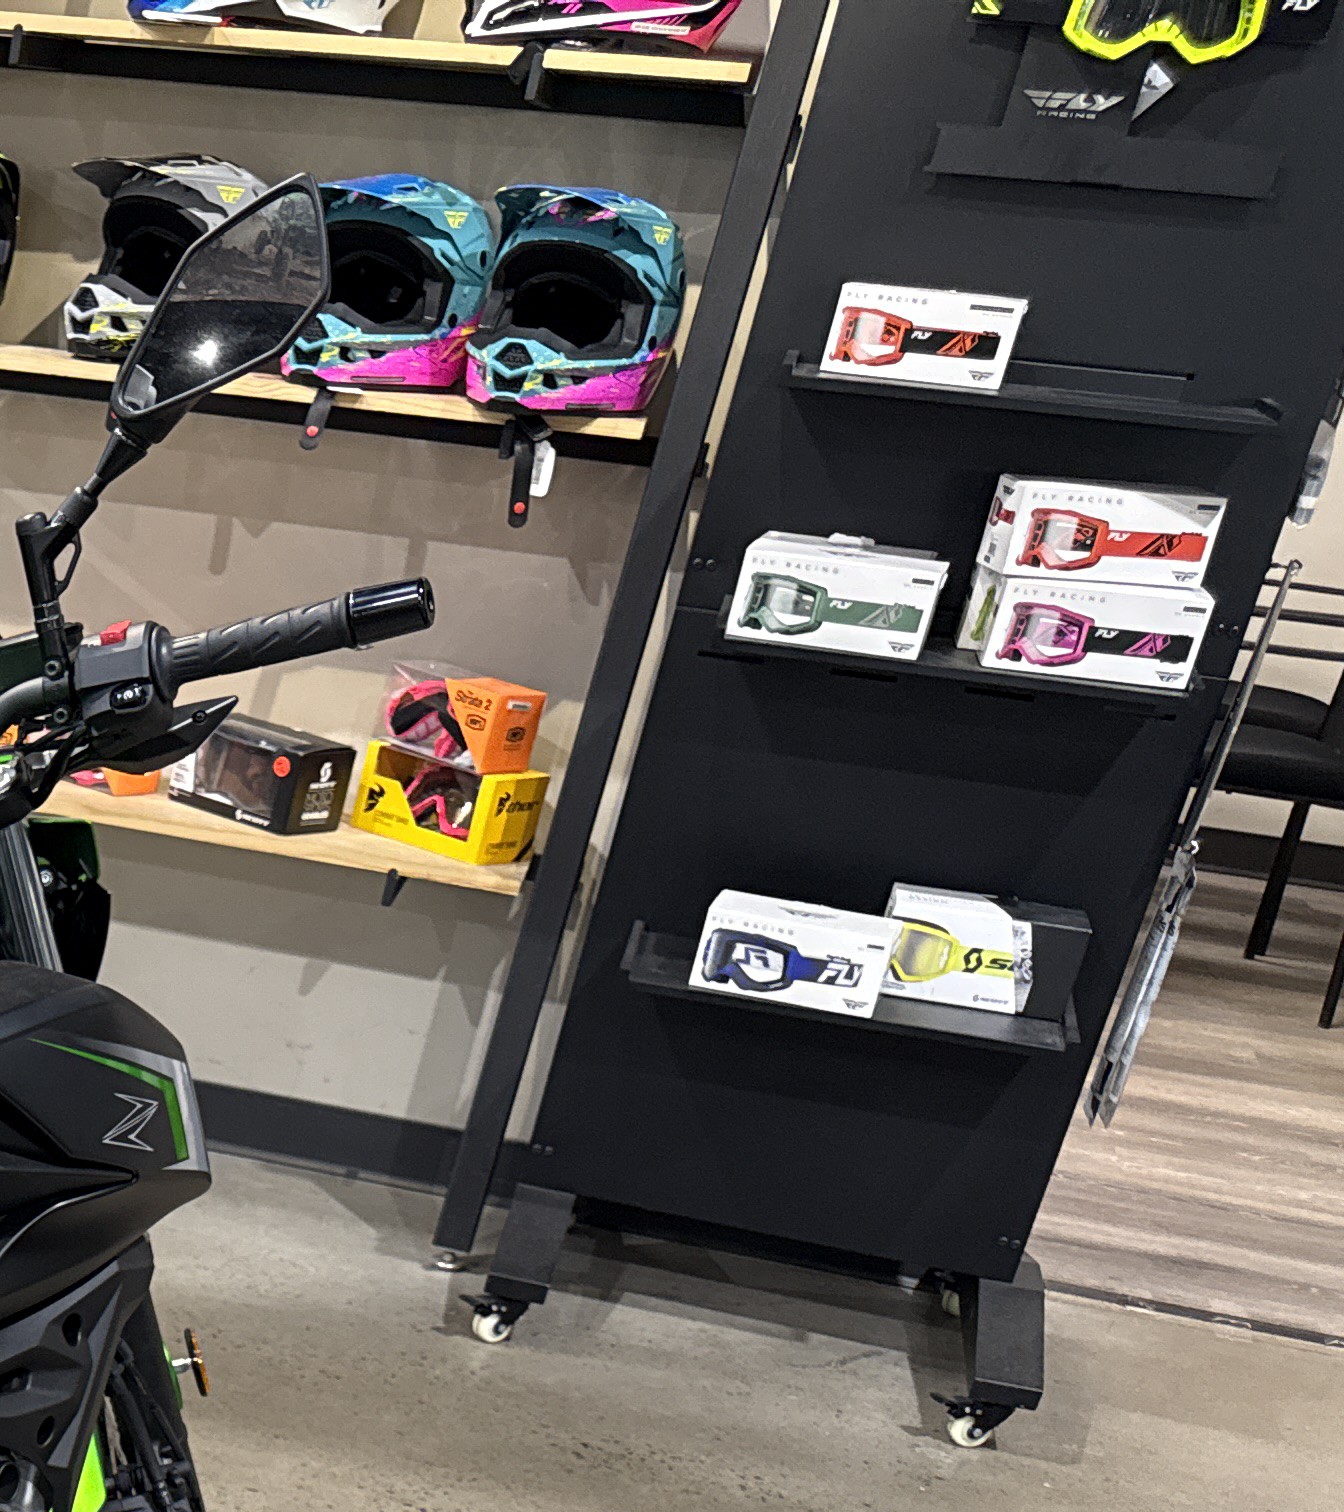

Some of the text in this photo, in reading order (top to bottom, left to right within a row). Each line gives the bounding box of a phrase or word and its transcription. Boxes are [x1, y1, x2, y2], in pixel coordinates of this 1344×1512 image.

[1024, 88, 1125, 111] FLY
[1036, 110, 1097, 120] RACING
[877, 294, 930, 306] RACING
[1032, 492, 1124, 506] FLY RACING
[1106, 531, 1132, 542] FLY
[1050, 591, 1107, 604] RACING
[1095, 628, 1120, 639] FLY
[816, 960, 864, 988] FLY
[101, 1091, 160, 1153] Z
